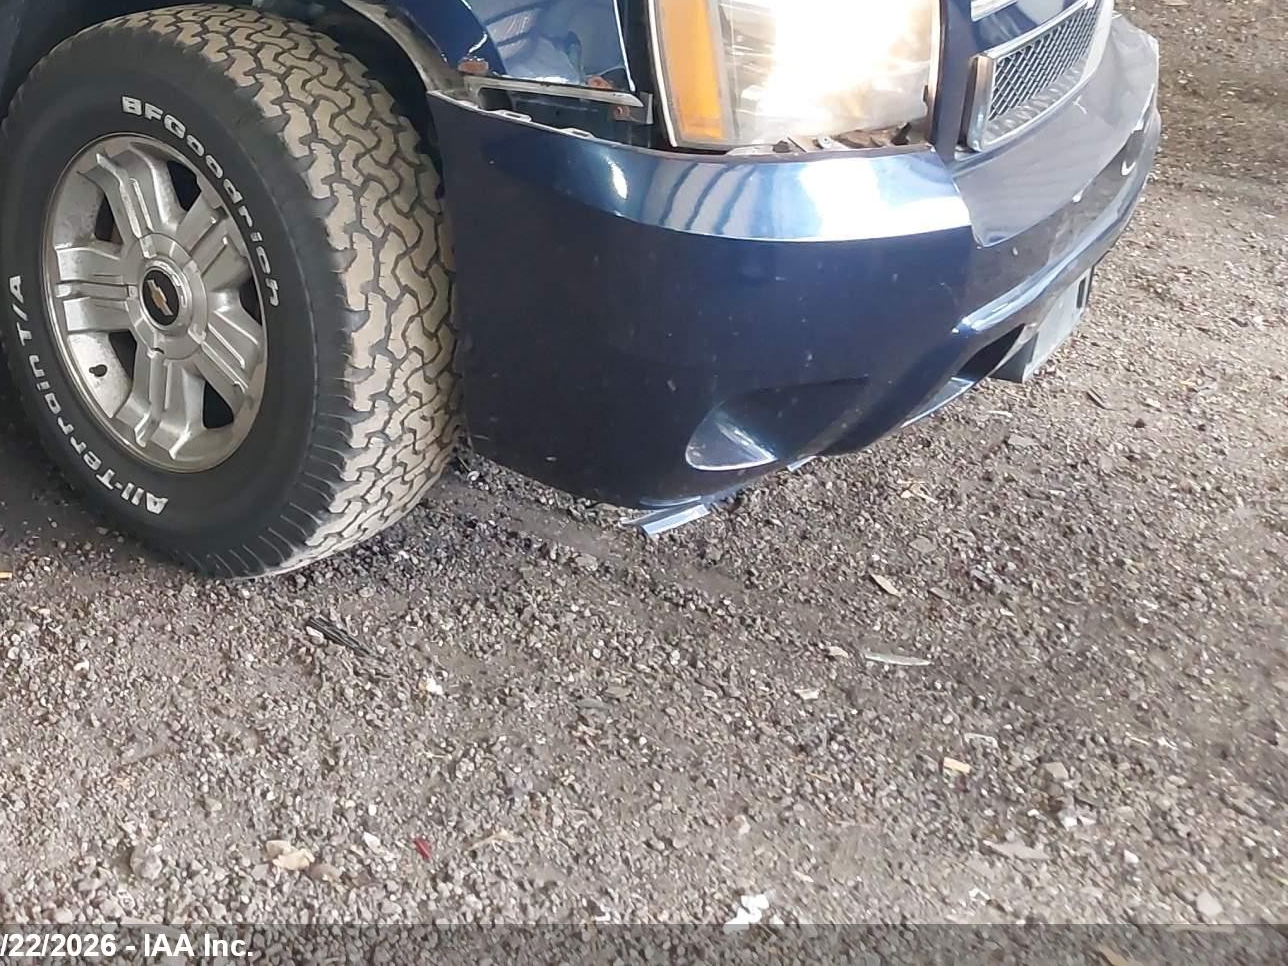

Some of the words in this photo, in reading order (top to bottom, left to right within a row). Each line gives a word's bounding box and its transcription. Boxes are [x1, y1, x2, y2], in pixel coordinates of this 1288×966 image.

[120, 95, 281, 308] BFGoodrich
[8, 274, 34, 347] T/A
[29, 354, 170, 517] All-Terrain
